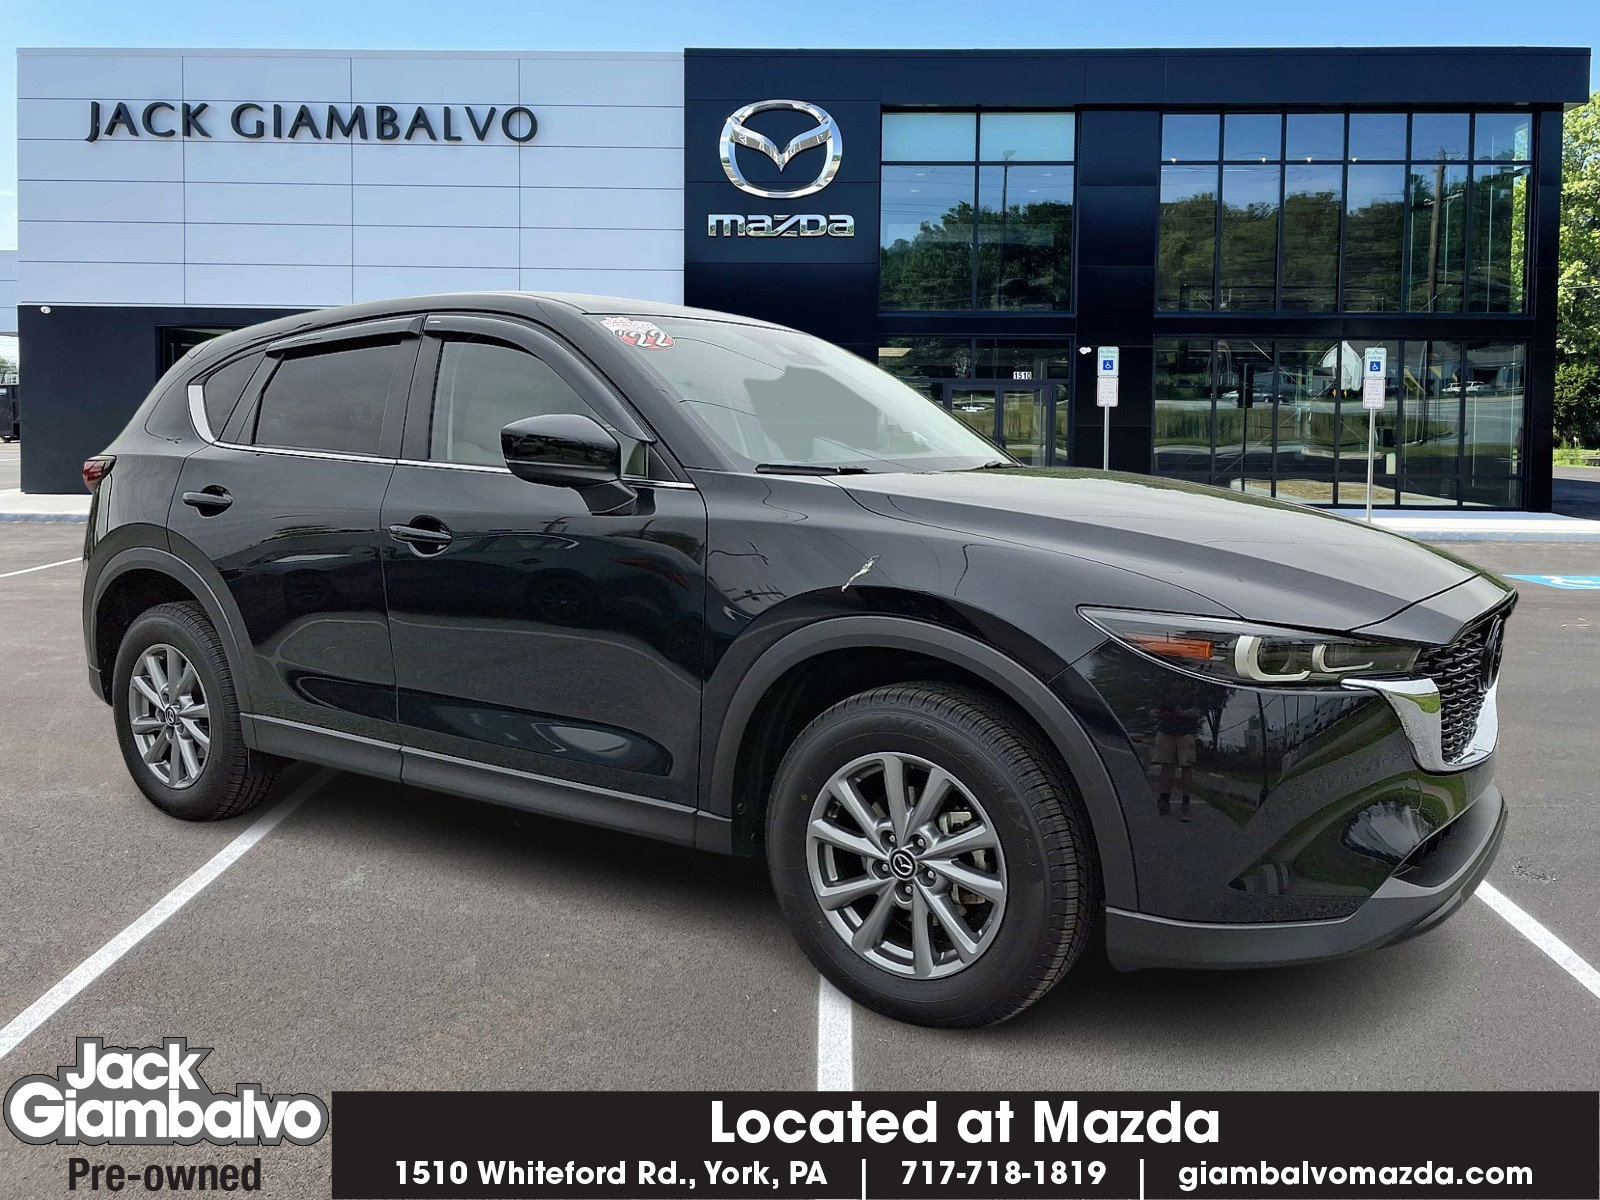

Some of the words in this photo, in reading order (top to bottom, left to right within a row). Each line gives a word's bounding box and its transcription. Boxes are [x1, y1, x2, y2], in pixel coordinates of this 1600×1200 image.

[85, 101, 212, 142] JACK
[231, 103, 538, 142] GIAMBALVO
[708, 214, 855, 237] mazda
[1014, 371, 1032, 380] 1510
